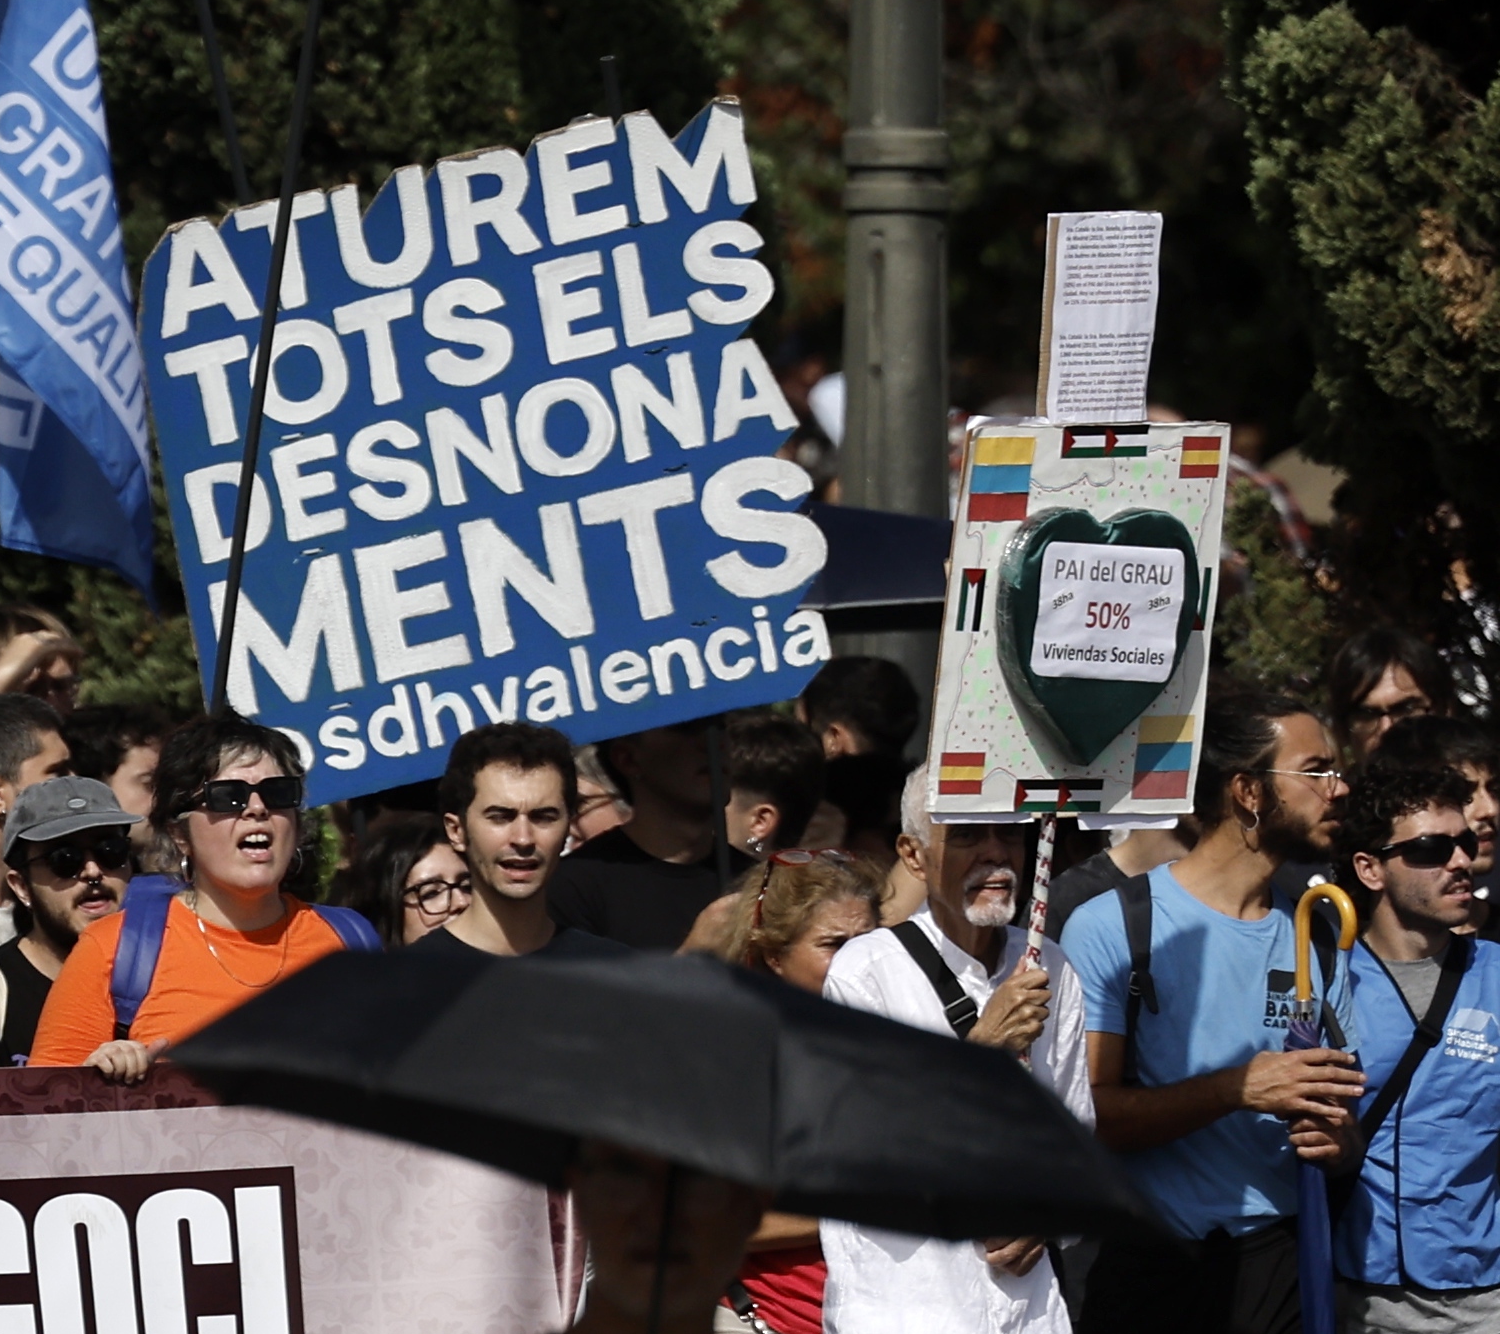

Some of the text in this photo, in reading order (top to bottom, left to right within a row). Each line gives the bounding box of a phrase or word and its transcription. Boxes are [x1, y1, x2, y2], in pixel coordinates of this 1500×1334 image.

[160, 97, 758, 339] ATUREM
[164, 278, 514, 447] TOTS
[532, 220, 775, 365] ELS
[184, 337, 799, 565] DESNONA
[207, 455, 829, 717] MENTS
[1054, 559, 1173, 586] PAI del GRAU
[1052, 591, 1074, 610] 38ha
[1148, 595, 1171, 610] 38ha
[1085, 601, 1132, 630] 50%
[1043, 643, 1165, 665] Viviendas Sociales
